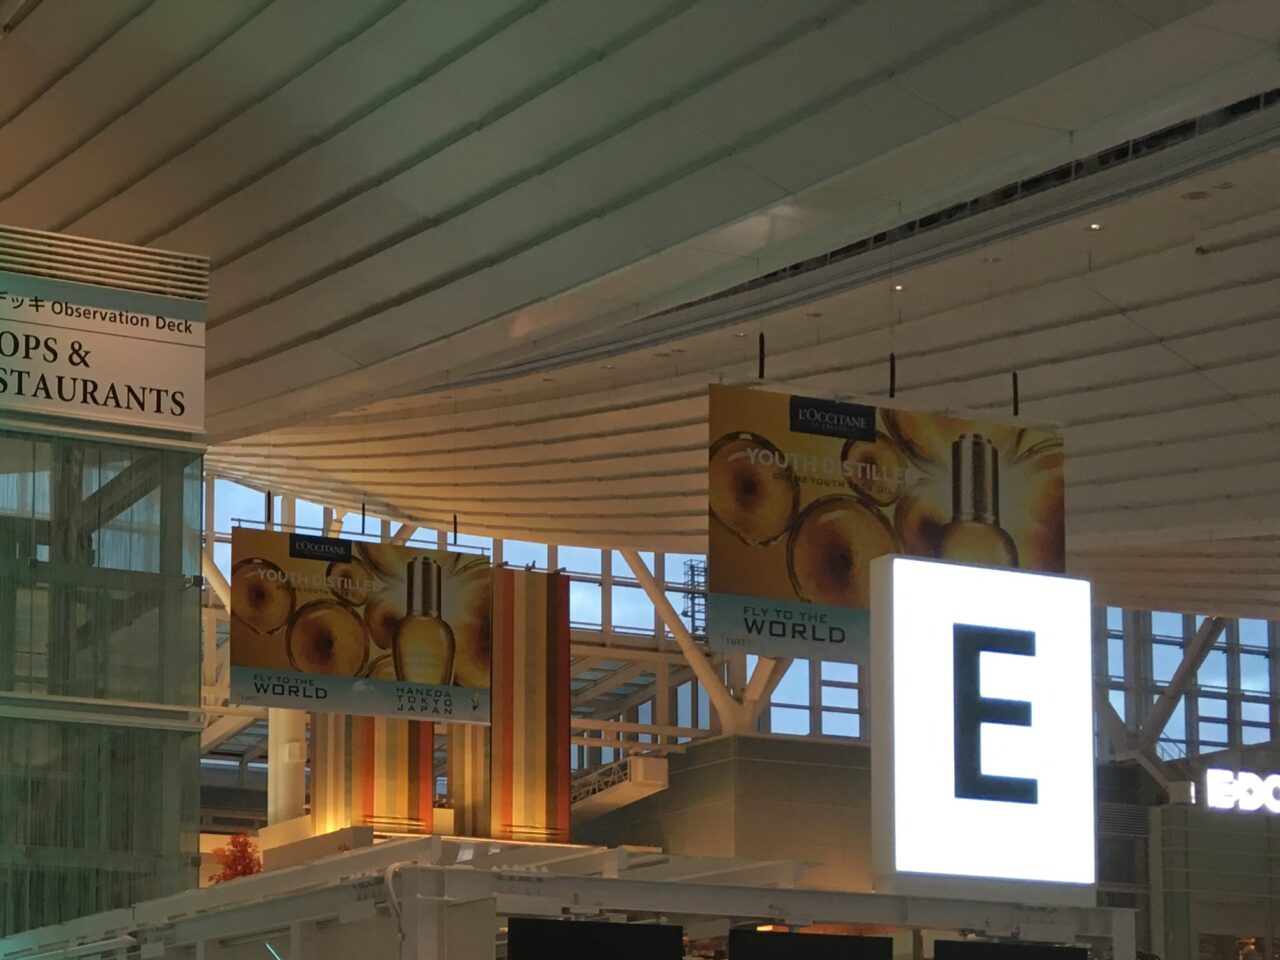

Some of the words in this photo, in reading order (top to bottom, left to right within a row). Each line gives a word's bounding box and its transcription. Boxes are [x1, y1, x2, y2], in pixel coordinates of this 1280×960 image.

[51, 300, 150, 329] Observation
[155, 315, 193, 335] Deck
[68, 340, 92, 369] &
[798, 407, 867, 429] L'OCCITANE
[746, 448, 818, 473] YOUTH
[811, 476, 845, 488] YOUTH
[295, 540, 346, 555] L'OCCITANE
[257, 568, 308, 584] YOUTH
[743, 606, 768, 617] FLY
[774, 609, 793, 620] TO
[800, 612, 828, 624] THE
[743, 618, 846, 643] WORLD
[253, 674, 273, 682] FLY
[277, 676, 290, 684] TO
[294, 678, 315, 686] THE
[254, 682, 328, 699] WORLD
[396, 686, 451, 699] HANEDA
[396, 695, 452, 707] TOKYO
[396, 703, 452, 715] JAPAN
[953, 623, 1039, 804] E
